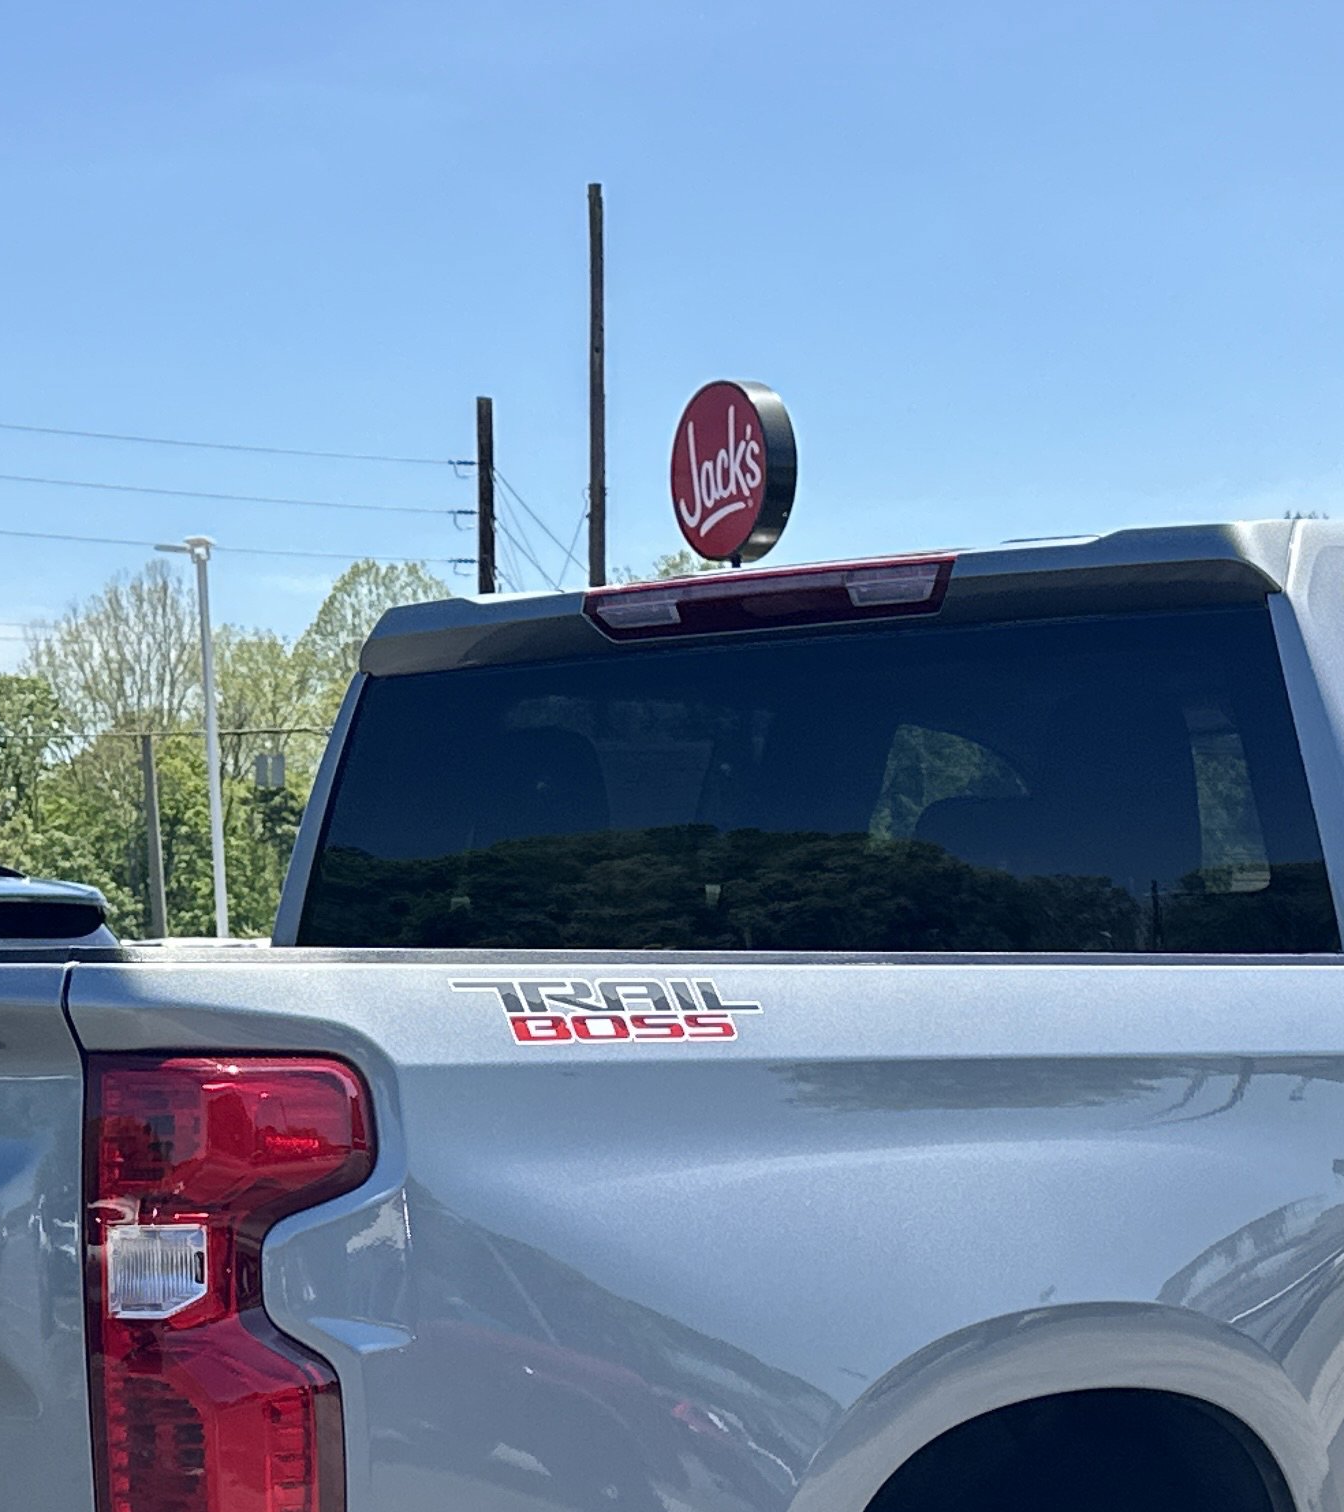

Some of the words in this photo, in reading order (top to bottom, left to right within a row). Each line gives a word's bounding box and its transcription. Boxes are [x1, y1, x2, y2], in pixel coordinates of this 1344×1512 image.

[679, 404, 761, 529] Jack's
[449, 978, 763, 1013] TRAIL
[507, 1012, 738, 1045] BOSS
